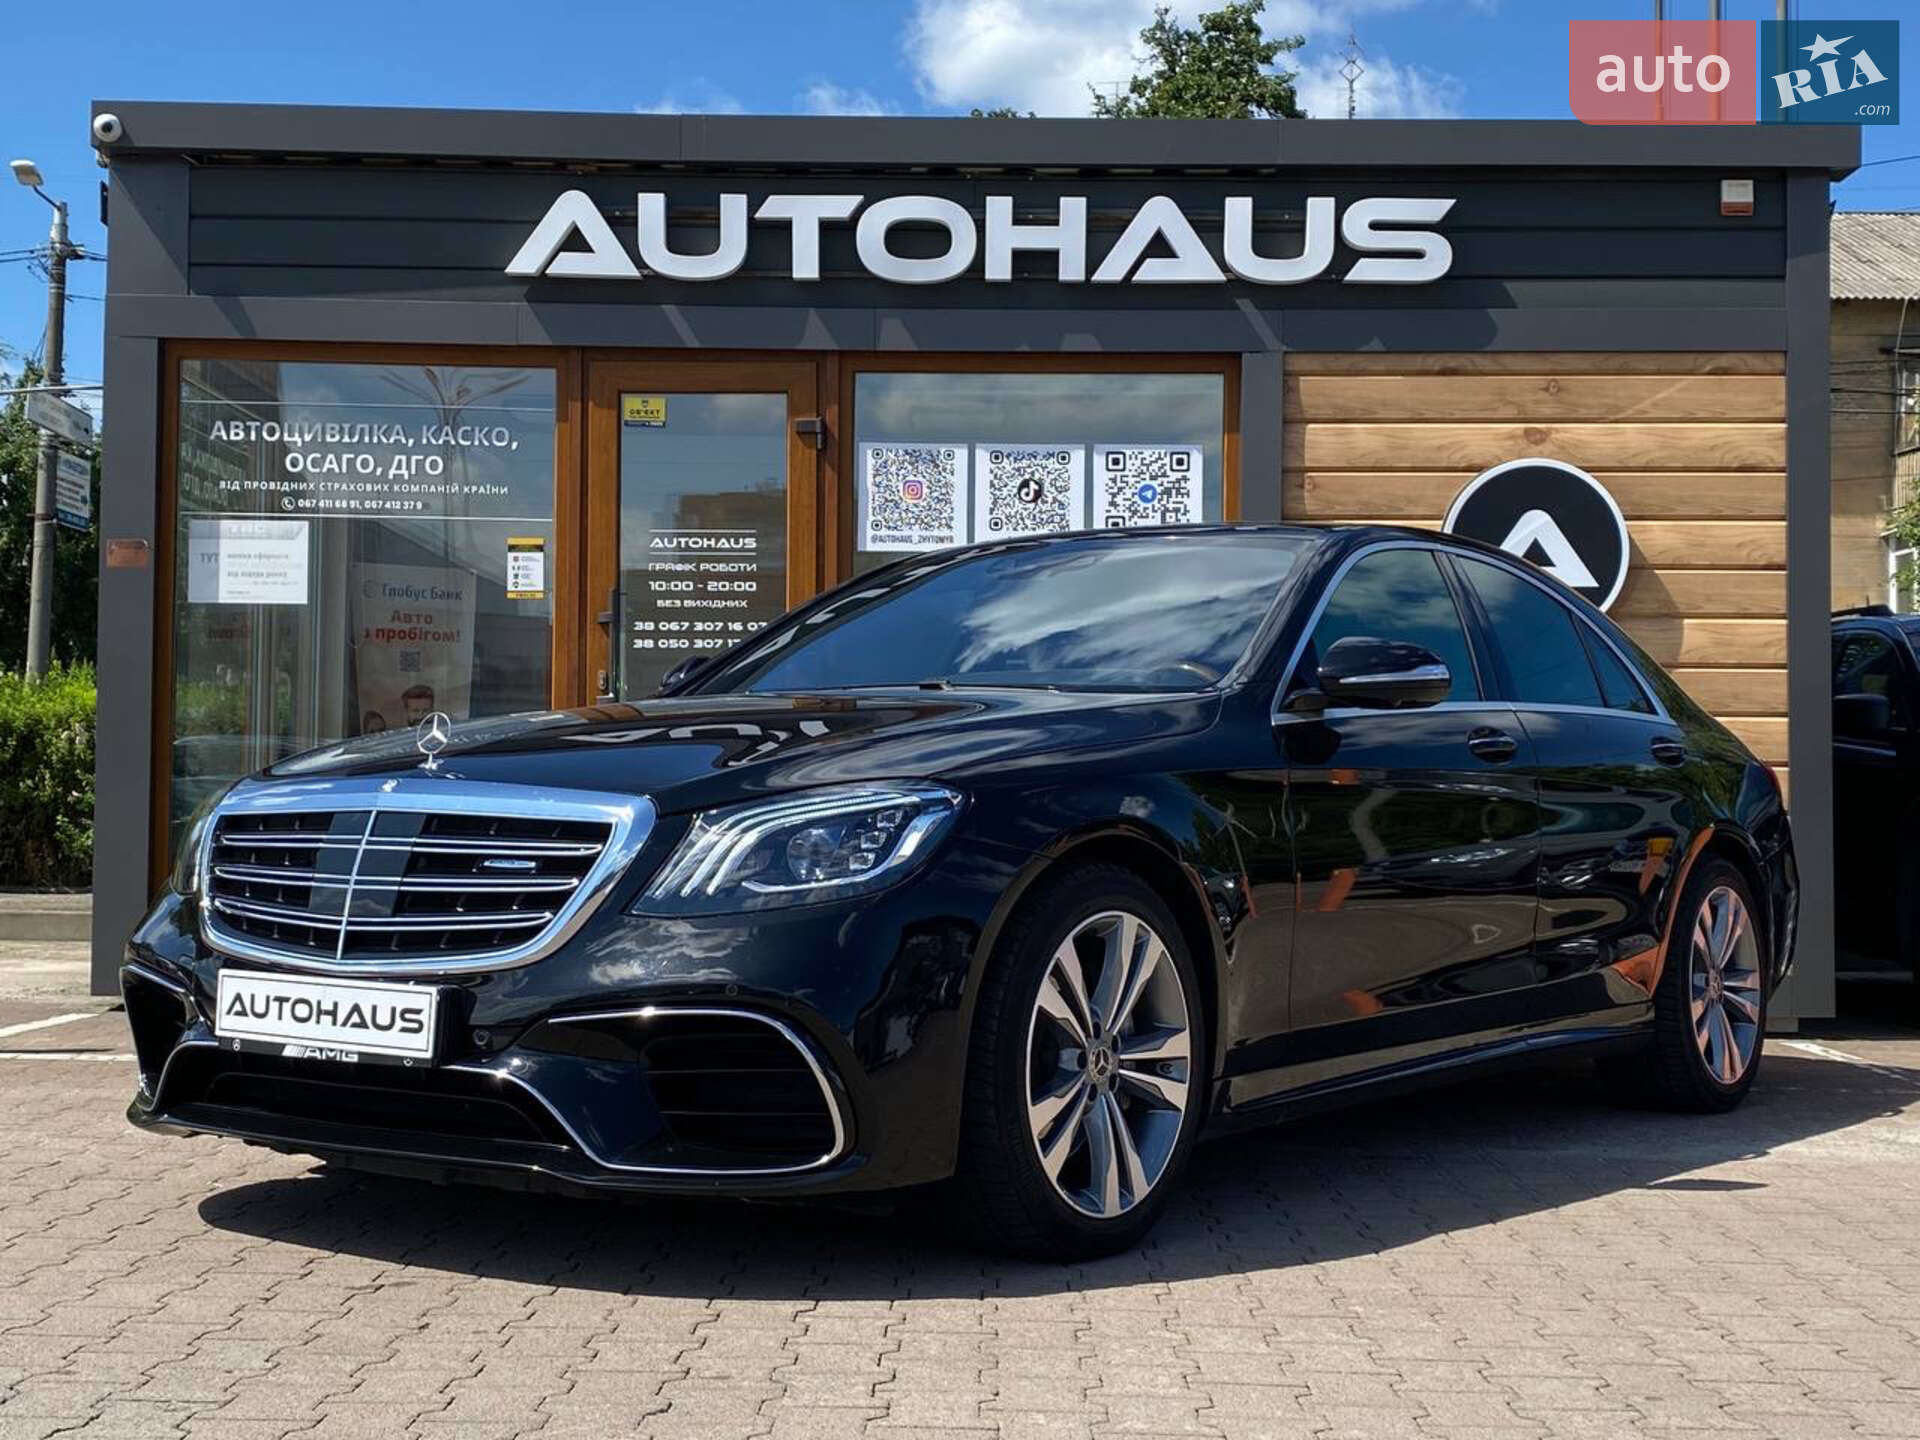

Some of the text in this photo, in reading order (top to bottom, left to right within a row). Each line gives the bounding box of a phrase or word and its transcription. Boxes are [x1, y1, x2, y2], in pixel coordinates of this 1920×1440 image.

[504, 189, 1457, 284] AUTOHAUS
[210, 420, 519, 450] АВТОЦИВІЛКА, КАСКО,
[285, 453, 444, 480] ОСАГО, ДГО
[219, 480, 509, 495] ВІД ПРОВІДНИХ СТРАХОВИХ КОМПАНІЙ КРАЇНИ
[649, 537, 757, 549] AUTOHAUS
[1499, 509, 1600, 587] A
[648, 562, 757, 572] ГРАФІК РОБОТИ
[648, 581, 693, 591] 10:00
[707, 581, 757, 592] 20:00
[656, 599, 748, 609] БЕЗ ВИХІДНИХ
[391, 610, 433, 625] Авто
[633, 621, 655, 631] 38
[658, 621, 690, 631] 067
[693, 621, 724, 631] 307
[727, 622, 743, 631] 16
[375, 626, 460, 644] пробігом!
[632, 638, 741, 648] 38 050 307 1
[226, 992, 424, 1034] AUTOHAUS
[303, 1046, 359, 1062] AMG
